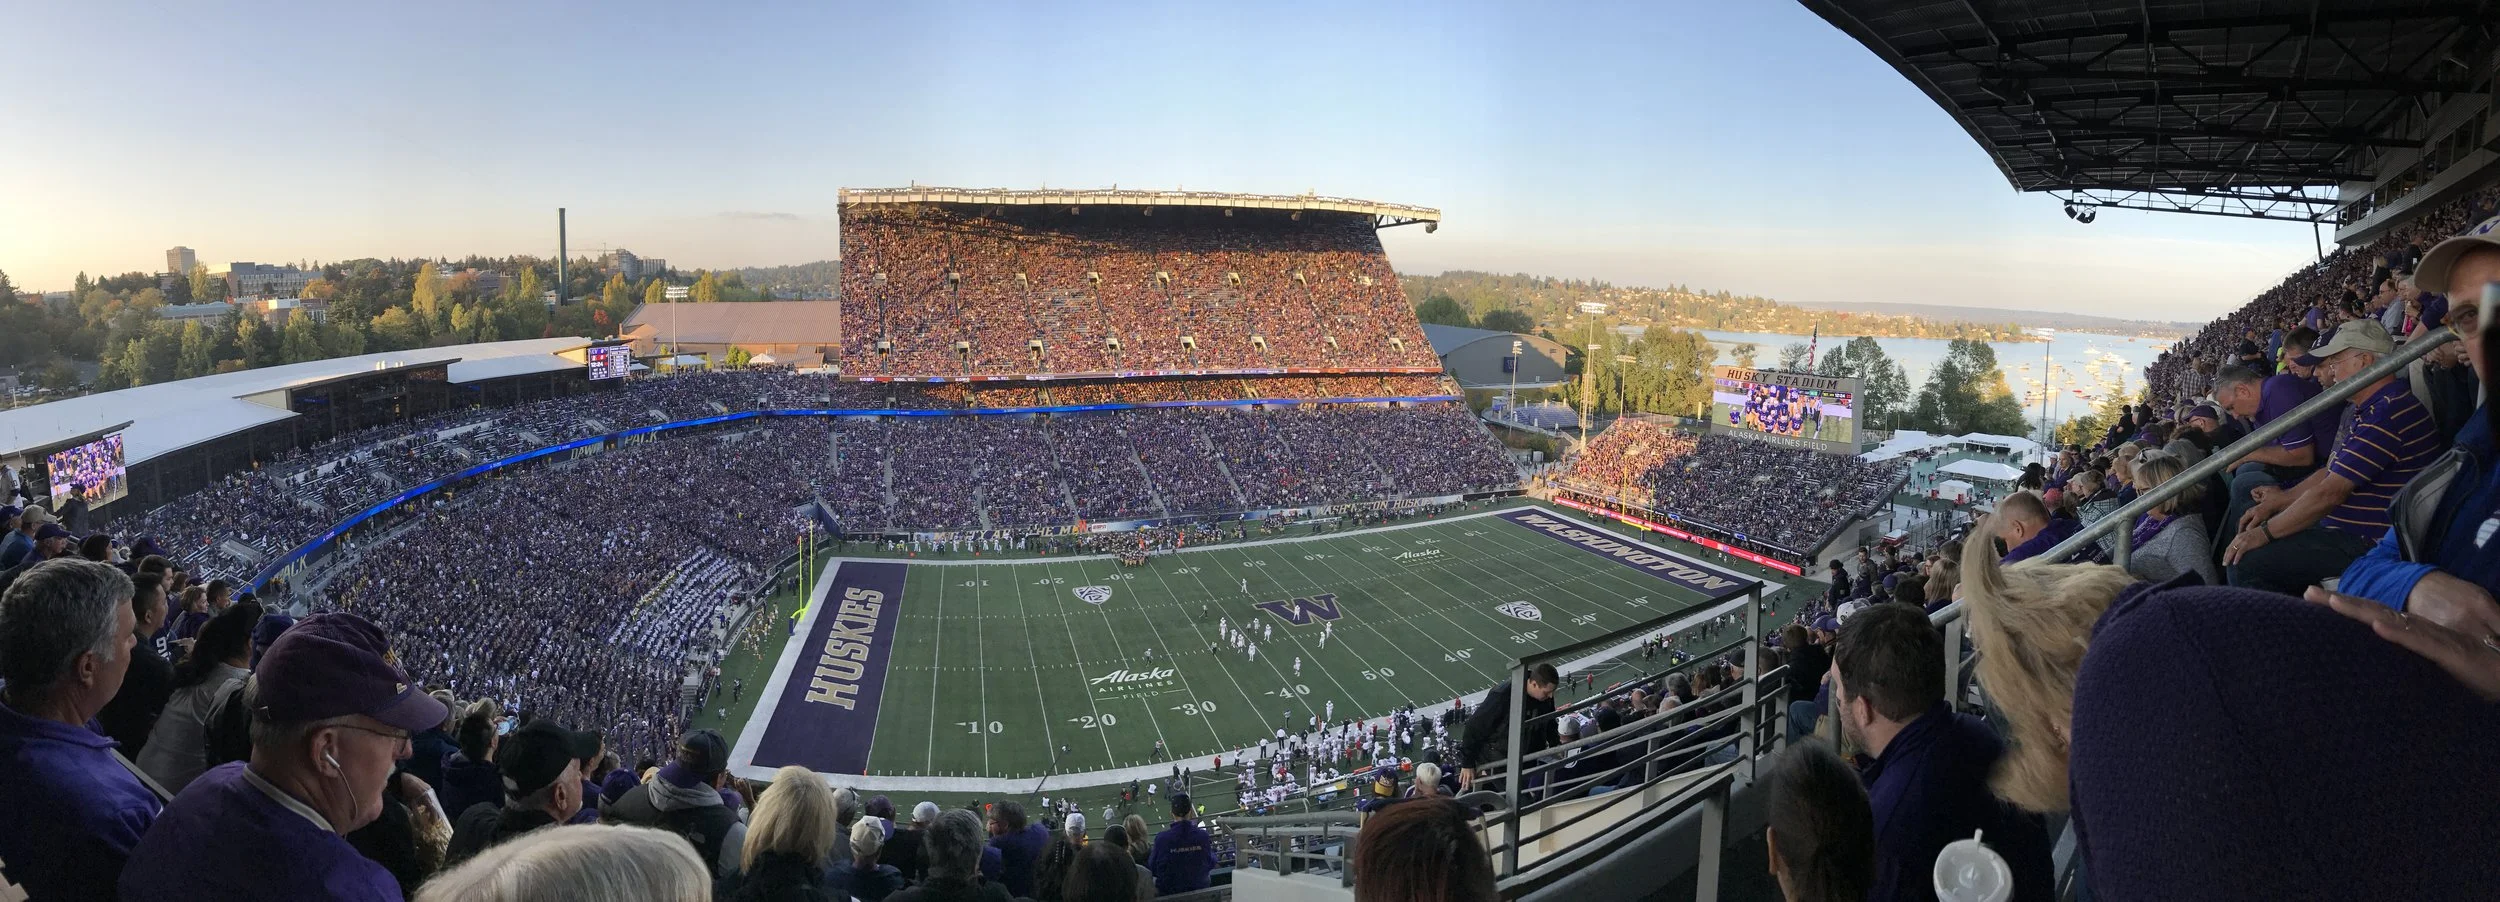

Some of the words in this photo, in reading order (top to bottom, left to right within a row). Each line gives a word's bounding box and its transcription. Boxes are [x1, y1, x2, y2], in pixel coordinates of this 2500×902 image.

[1727, 369, 1769, 383] HUSKY
[1776, 374, 1838, 390] STADIUM
[1728, 429, 1760, 441] ALASKA
[1763, 435, 1801, 448] AIRLINES
[1803, 440, 1828, 451] FIELD
[1392, 548, 1441, 560] Alaska
[1515, 514, 1739, 590] WASHINGTON
[1252, 592, 1343, 627] W
[1570, 613, 1596, 626] 20
[1510, 631, 1539, 645] 30
[804, 586, 884, 711] HUSKIES
[1444, 649, 1472, 664] 40
[1089, 666, 1175, 686] Alaska
[1361, 667, 1396, 681] 50
[1098, 680, 1174, 693] AIRLINES
[1279, 684, 1311, 700] 40
[1122, 690, 1159, 700] FIELD
[1182, 700, 1217, 716] 30
[968, 721, 1004, 734] 10
[1080, 713, 1117, 729] 20
